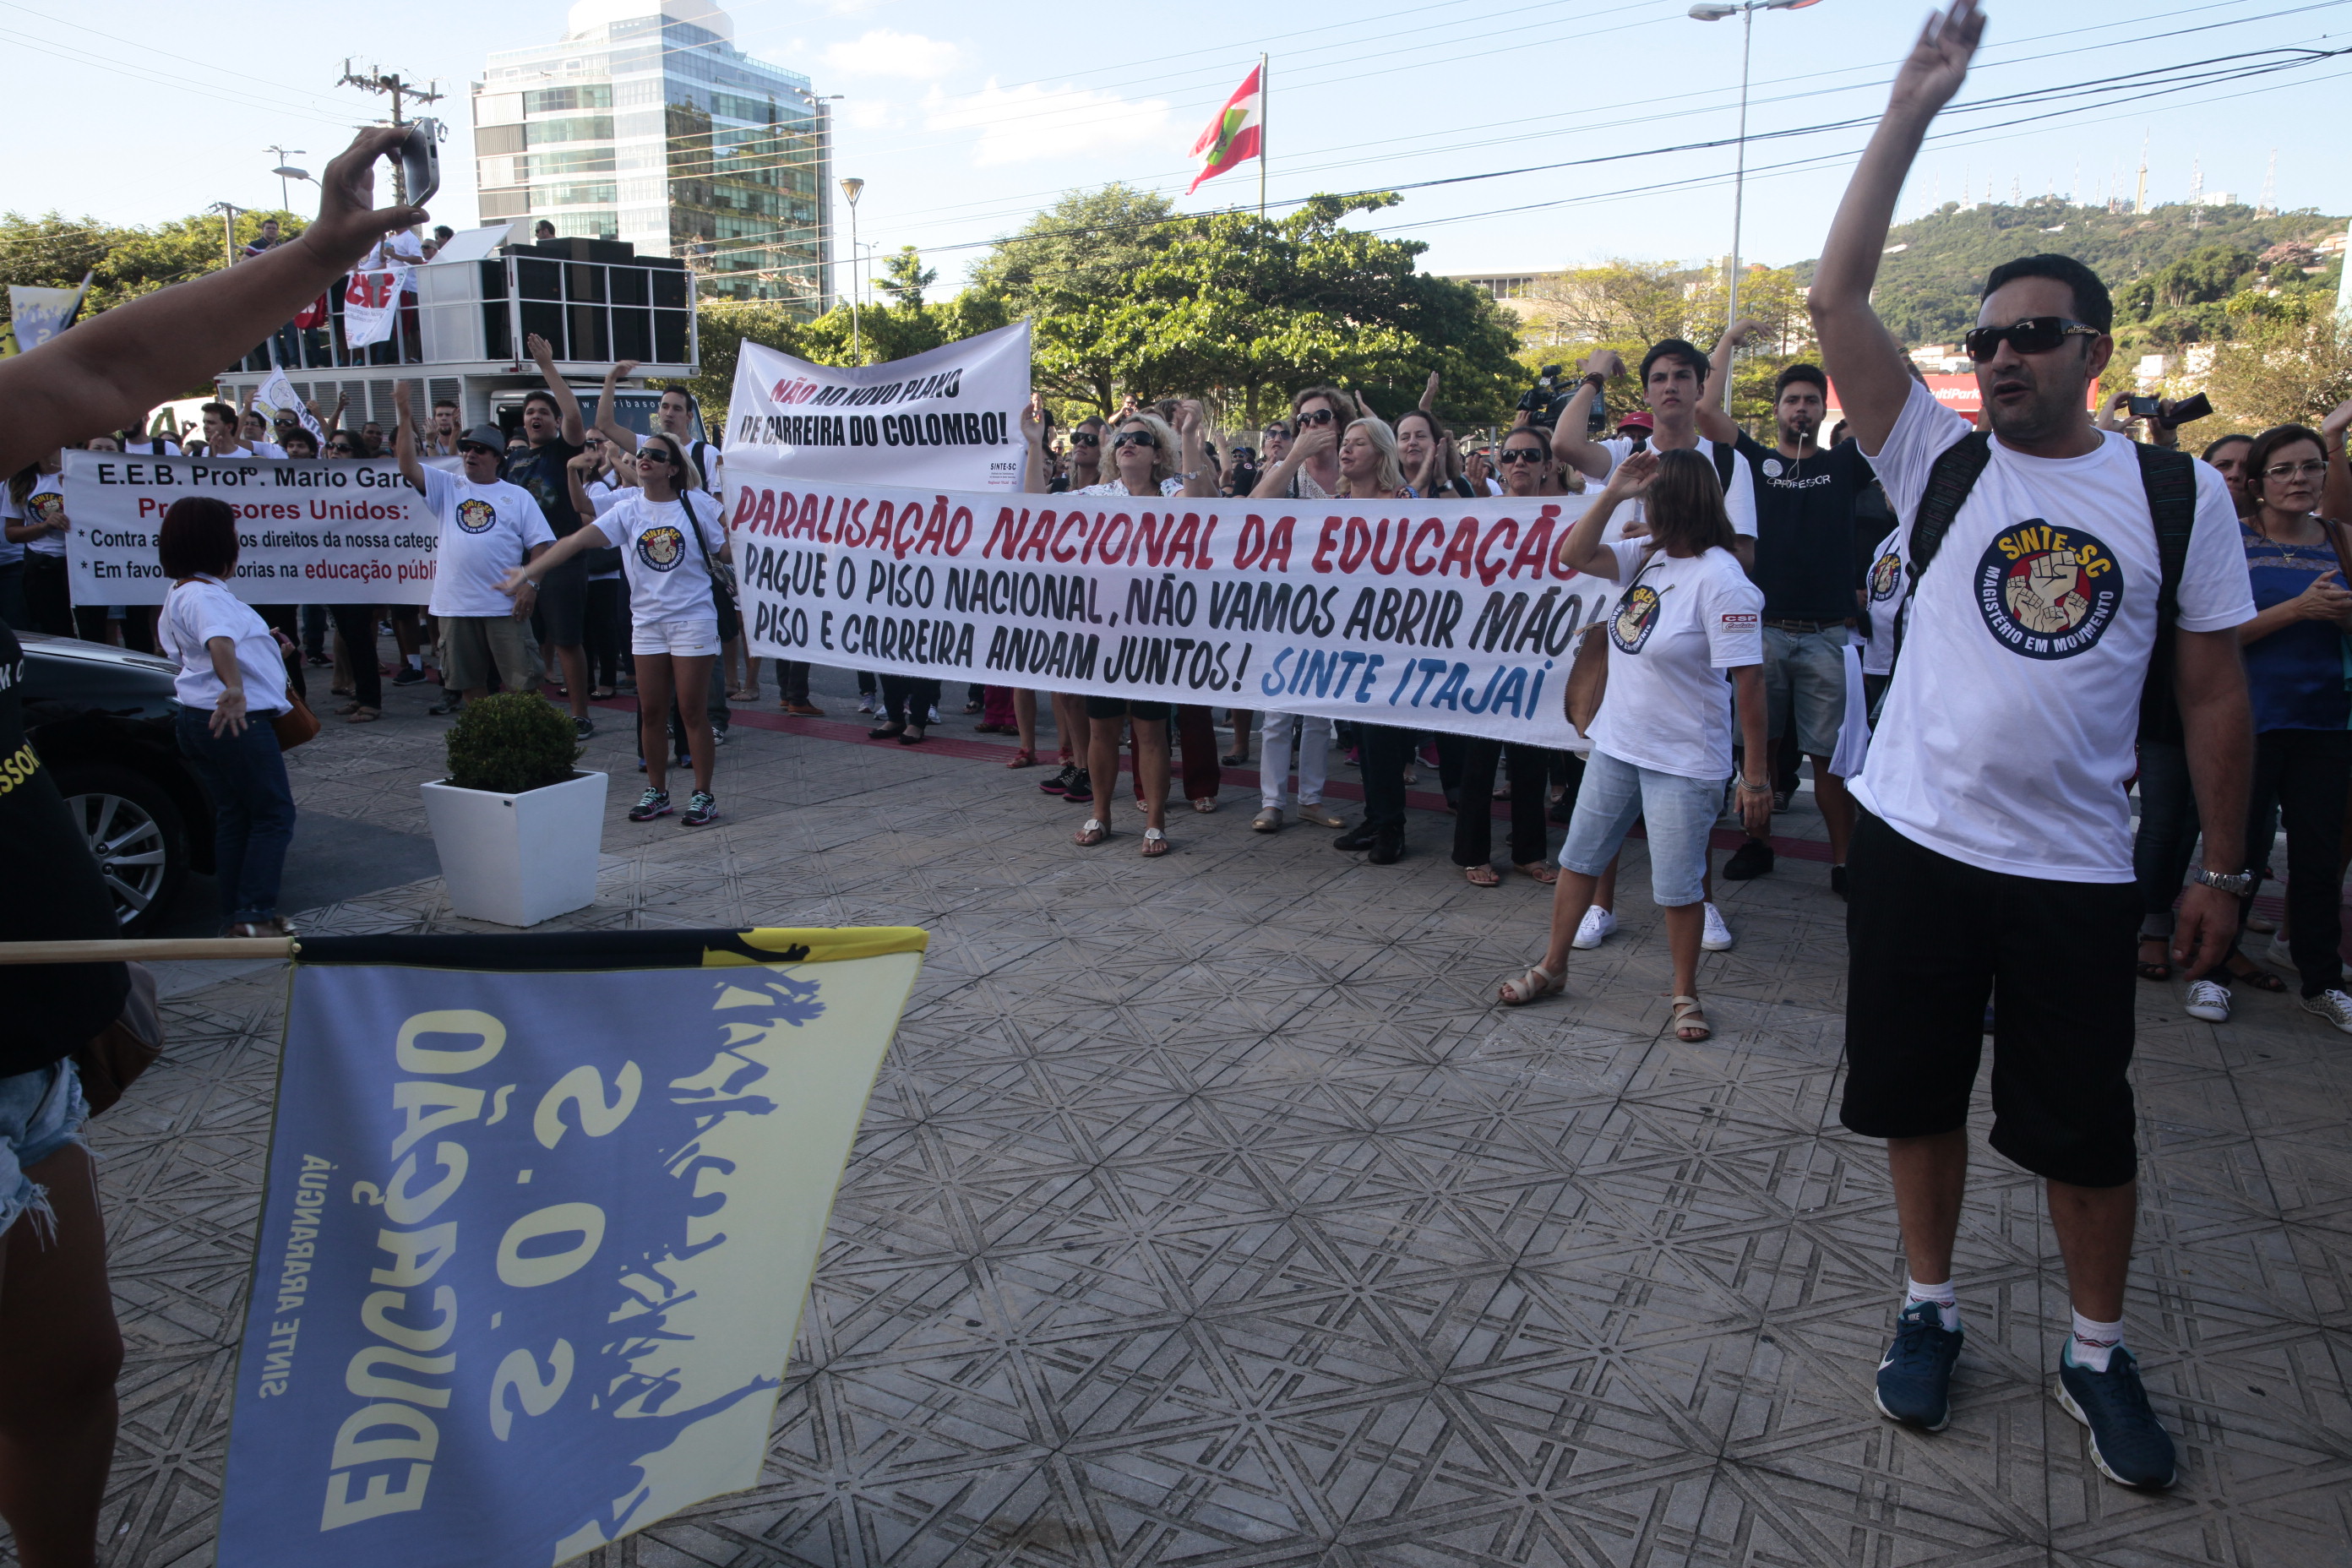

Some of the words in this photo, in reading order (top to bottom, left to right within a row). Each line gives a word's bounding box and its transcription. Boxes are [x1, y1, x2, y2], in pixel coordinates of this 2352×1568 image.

[769, 377, 818, 405] NÃO
[808, 385, 848, 406] AO
[839, 383, 902, 406] NOVO
[896, 368, 963, 404] PLANO
[1930, 388, 1980, 400] ultiPark
[738, 415, 763, 444] DE
[762, 415, 846, 446] CARREIRA
[850, 415, 879, 446] DO
[882, 411, 1009, 446] COLOMBO!
[98, 464, 182, 486] E.E.B.
[275, 466, 346, 487] Mario
[990, 462, 1016, 471] SINTE-SC
[309, 499, 409, 520] Unidos:
[91, 529, 147, 547] Contra
[262, 531, 318, 547] direitos
[323, 531, 341, 547] da
[346, 535, 389, 548] nossa
[642, 527, 681, 542] SINTE-SC
[731, 485, 973, 560] PARALISAÇÃO
[982, 507, 1218, 570] NACIONAL
[1233, 514, 1297, 573] DA
[1998, 525, 2111, 578] SINTE-SC
[94, 561, 122, 579] Em
[127, 560, 163, 579] favo
[280, 564, 298, 578] na
[305, 558, 392, 584] educação
[744, 542, 828, 600] PAGUE
[836, 556, 856, 601] O
[866, 559, 934, 608] PISO
[1124, 573, 1197, 627] NÃO
[1209, 580, 1340, 639] VAMOS
[1342, 586, 1463, 649] ABRIR
[1982, 565, 2023, 644] MAGISTÉRIO
[2024, 638, 2049, 653] EM
[754, 600, 808, 648] PISO
[820, 610, 834, 651] E
[841, 613, 975, 667] CARREIRA
[985, 625, 1100, 681] ANDAM
[1103, 635, 1252, 693] JUNTOS!
[1260, 646, 1385, 703] SINTE
[1908, 1312, 1920, 1321] NIKE
